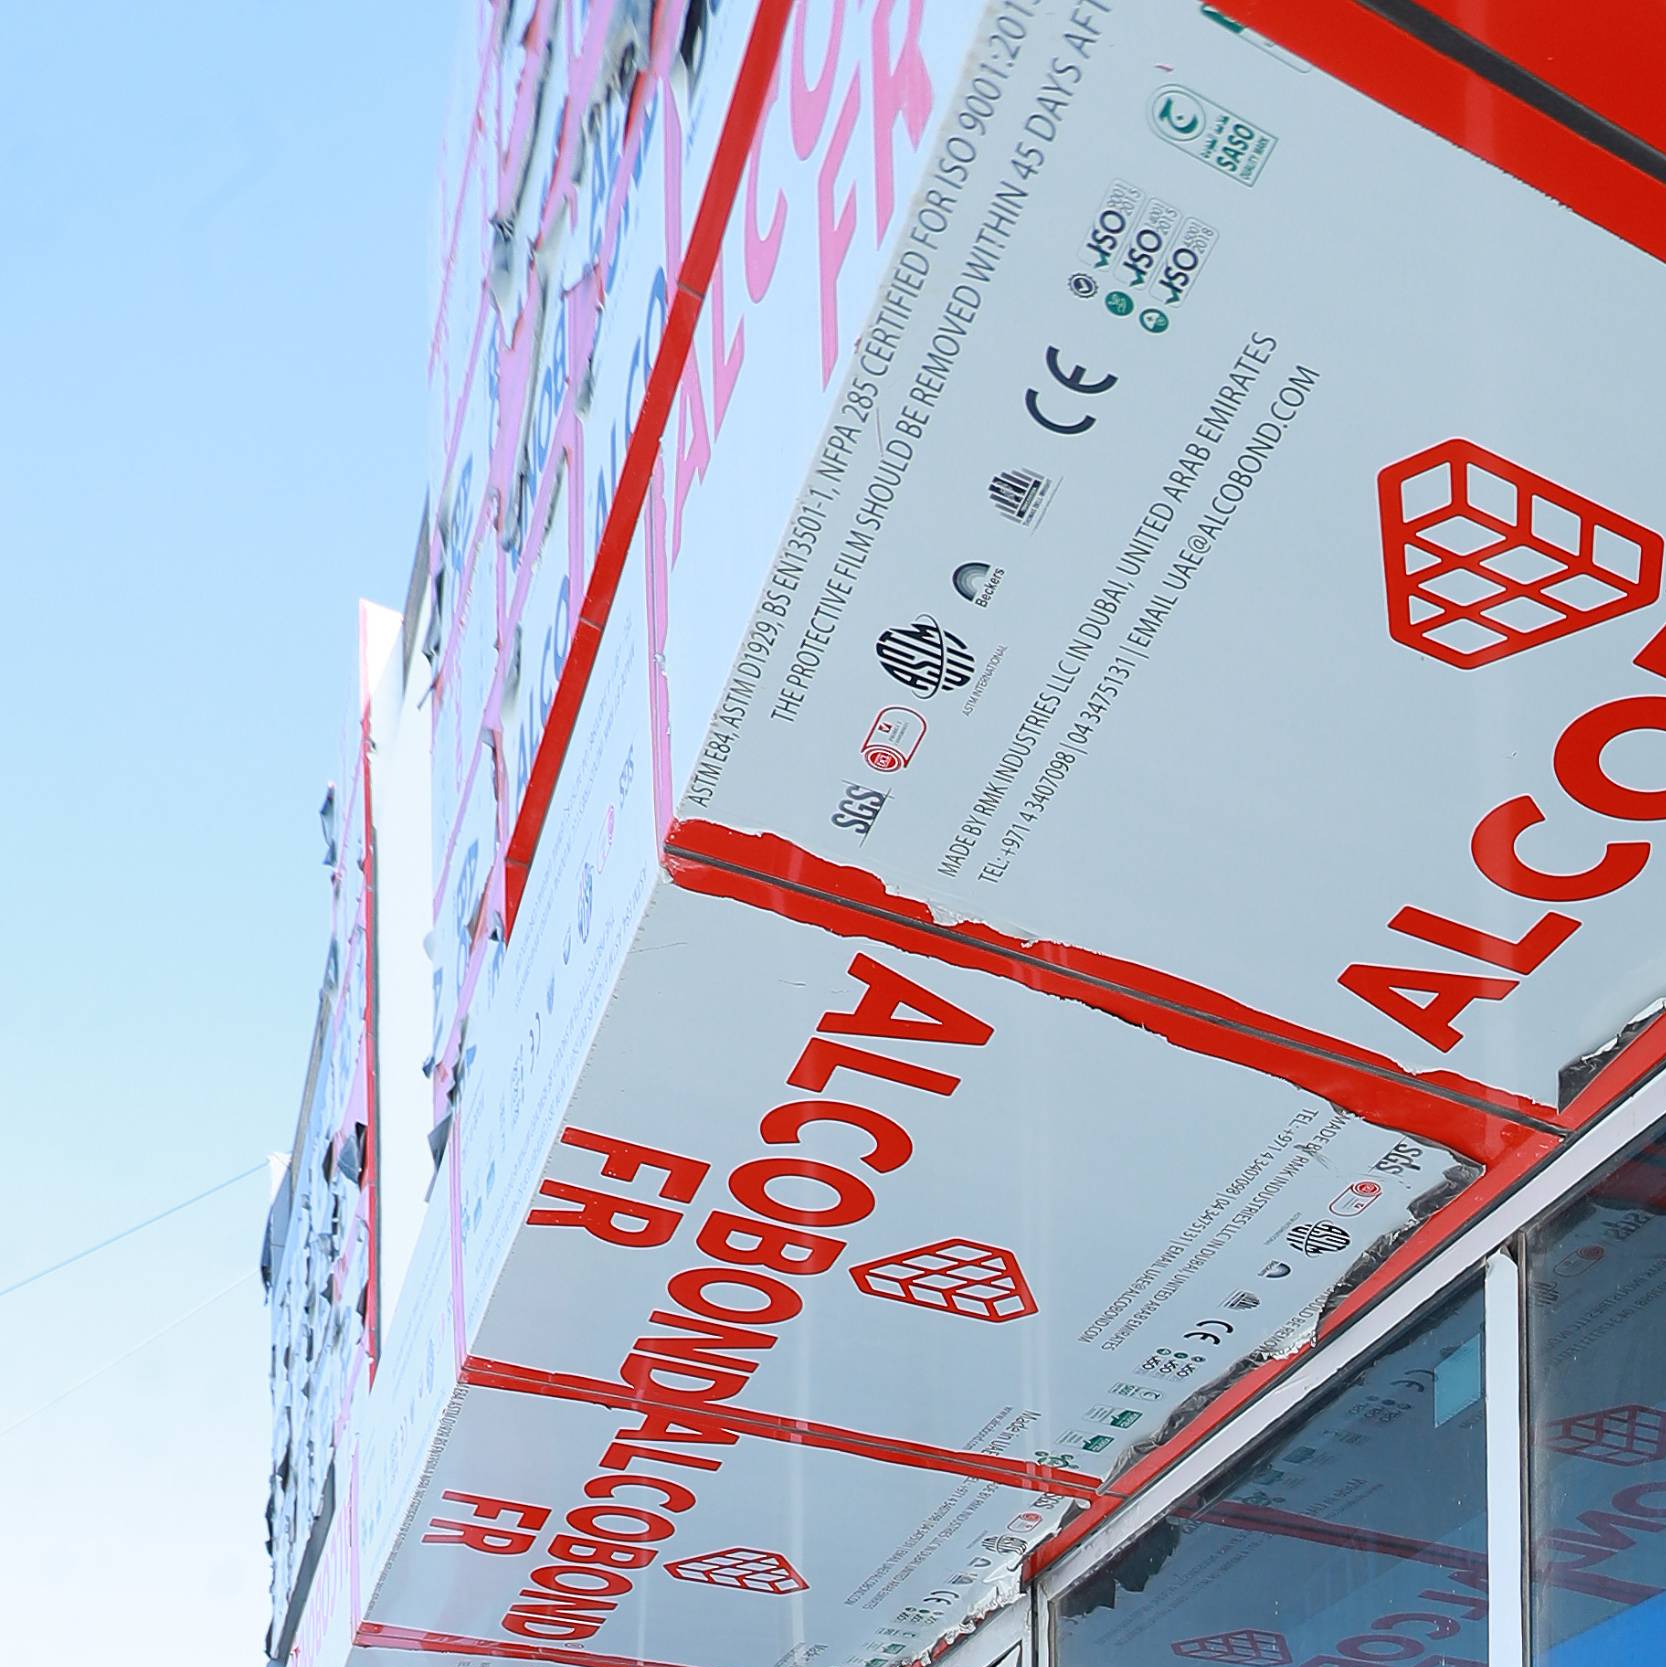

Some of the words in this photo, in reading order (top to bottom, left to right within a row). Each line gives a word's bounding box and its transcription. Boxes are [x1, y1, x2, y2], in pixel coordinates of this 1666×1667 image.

[958, 0, 1040, 136] 9001:201
[1024, 57, 1082, 142] DAYS
[934, 137, 977, 190] ISO
[1010, 141, 1045, 181] 45
[1217, 124, 1254, 172] SASO
[909, 189, 958, 250] FOR
[961, 180, 1029, 282] WITHIN
[1087, 209, 1126, 257] ISO
[1123, 228, 1163, 275] ISO
[1159, 247, 1199, 293] ISO
[860, 250, 930, 377] CERTIFIED
[909, 285, 982, 408] REMOVED
[841, 377, 879, 424] 285
[1024, 345, 1119, 435] CE
[1194, 331, 1277, 444] EMIRATES
[894, 405, 930, 440] BE
[816, 426, 862, 482] NFPA
[1161, 364, 1321, 590] UAE@ALCOBOND.COM
[1162, 442, 1211, 504] ARAB
[855, 432, 914, 532] SHOULD
[774, 488, 841, 590] EN13501-1,
[833, 529, 875, 581] FILM
[1115, 502, 1174, 576] UNITED
[762, 591, 791, 617] BS
[975, 567, 1006, 609] Beckers
[1077, 579, 1136, 643] DUBAI,
[785, 578, 854, 690] PROTECTIVE
[1126, 593, 1179, 650] EMAIL
[737, 620, 786, 680] D1929,
[1064, 637, 1095, 662] IN
[1045, 659, 1082, 695] LLC
[1079, 656, 1136, 725] 3475131
[721, 678, 757, 730] ASTM
[770, 687, 806, 723] THE
[705, 729, 740, 765] E84,
[991, 690, 1062, 784] INDUSTRIES
[1063, 718, 1094, 745] 04
[688, 756, 720, 808] ASTM
[969, 780, 1009, 818] RMK
[1021, 748, 1076, 814] 3407098
[831, 784, 884, 834] SGS
[960, 811, 988, 837] BY
[1014, 807, 1039, 825] 4
[936, 834, 977, 878] MADE
[1000, 819, 1031, 857] +971
[977, 857, 1011, 884] TEL:
[618, 952, 995, 1403] ALCOBOND
[1374, 1143, 1424, 1177] SGS
[526, 1126, 712, 1249] FR
[1230, 1173, 1290, 1224] INDUSTRIES
[421, 1490, 552, 1557] FR
[500, 1408, 742, 1642] ALCOBOND
